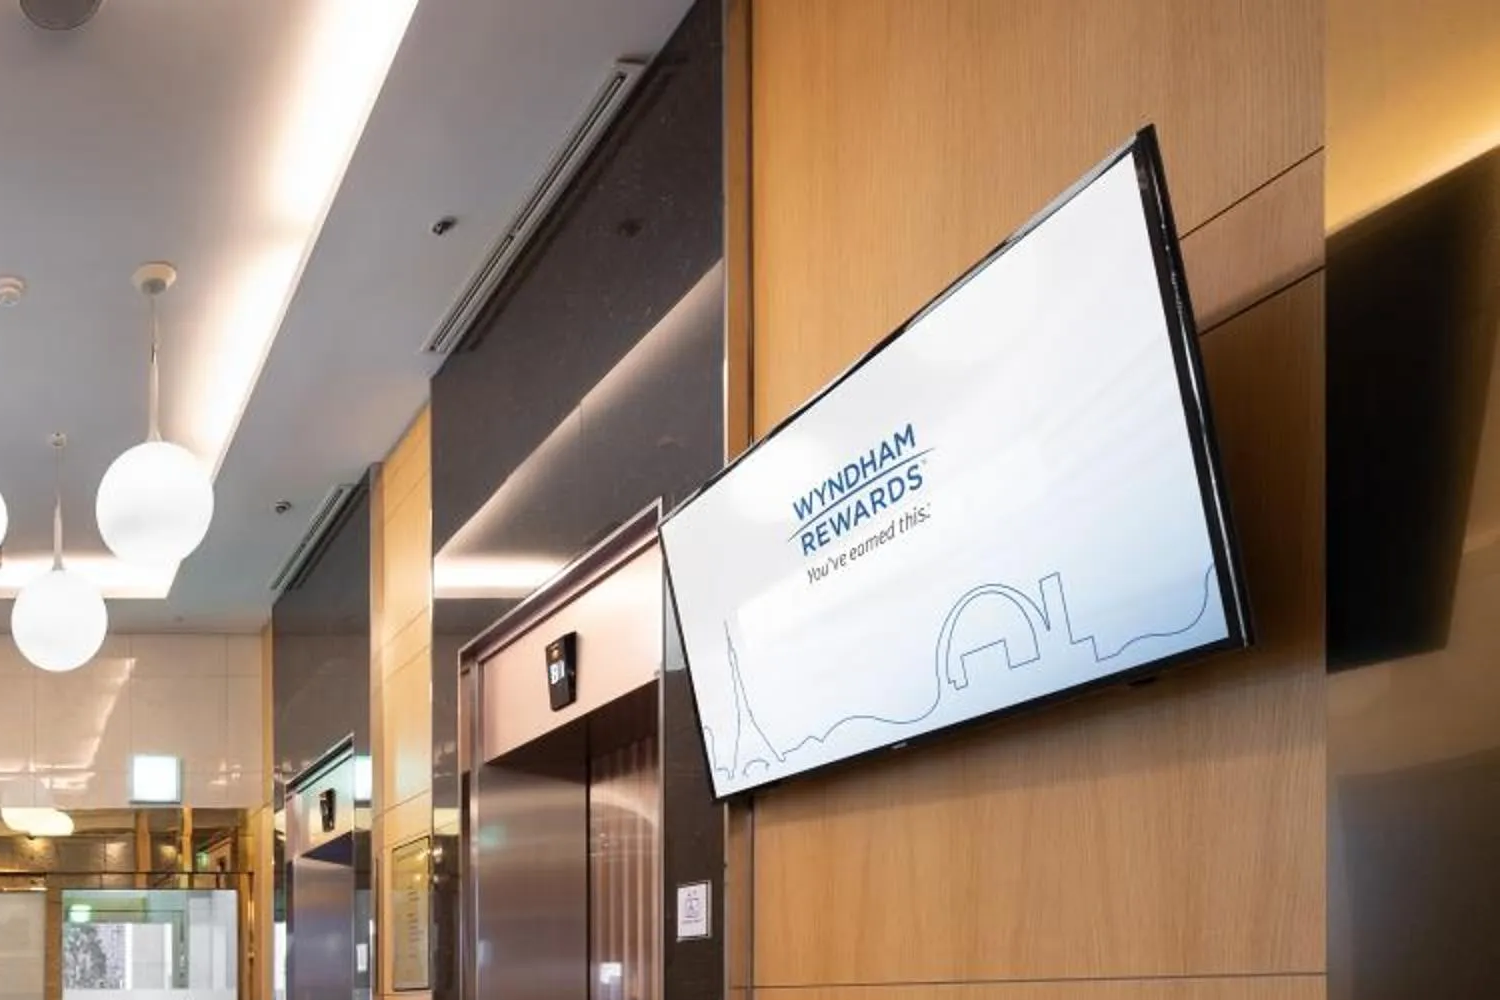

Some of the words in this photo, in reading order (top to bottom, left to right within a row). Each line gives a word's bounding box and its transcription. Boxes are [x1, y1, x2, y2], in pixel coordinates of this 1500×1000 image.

[792, 422, 916, 522] WYNDHAM
[800, 463, 923, 557] REWARDS
[807, 553, 847, 584] You've
[849, 520, 896, 561] earned
